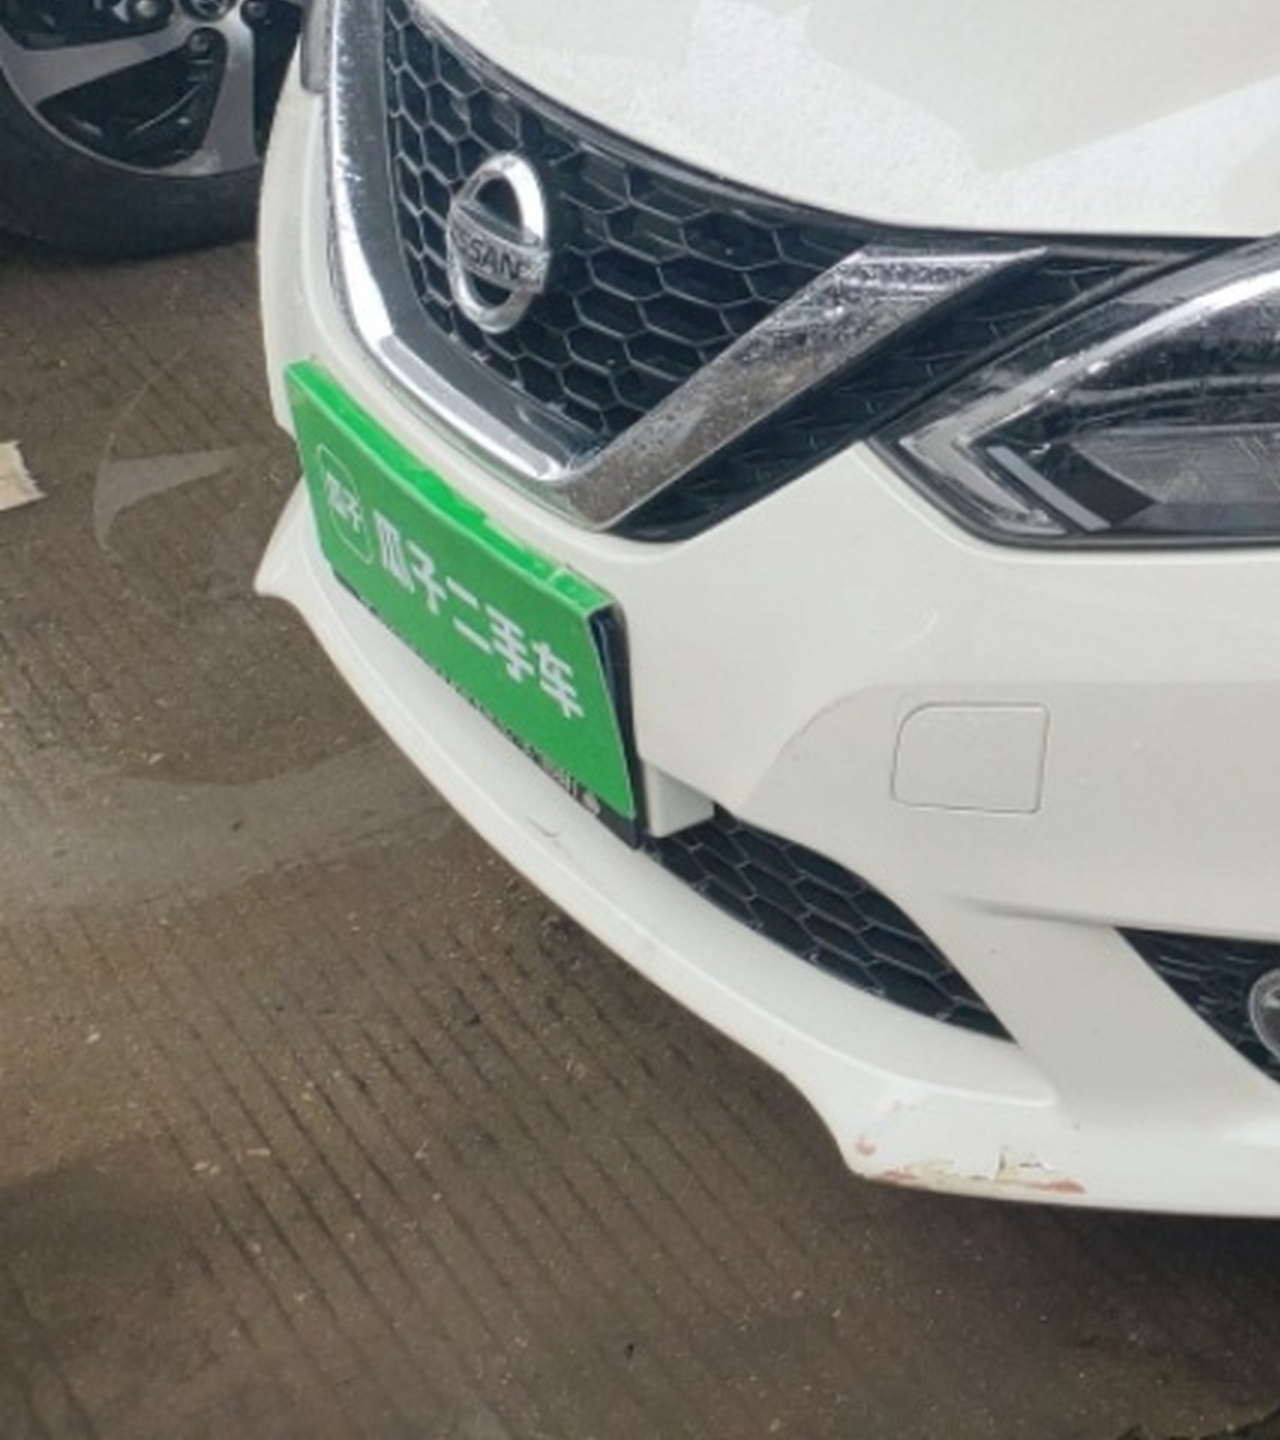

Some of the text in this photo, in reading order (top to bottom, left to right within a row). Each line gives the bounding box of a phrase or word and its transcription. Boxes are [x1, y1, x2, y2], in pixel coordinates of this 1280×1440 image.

[373, 507, 585, 720] 瓜子二手车
